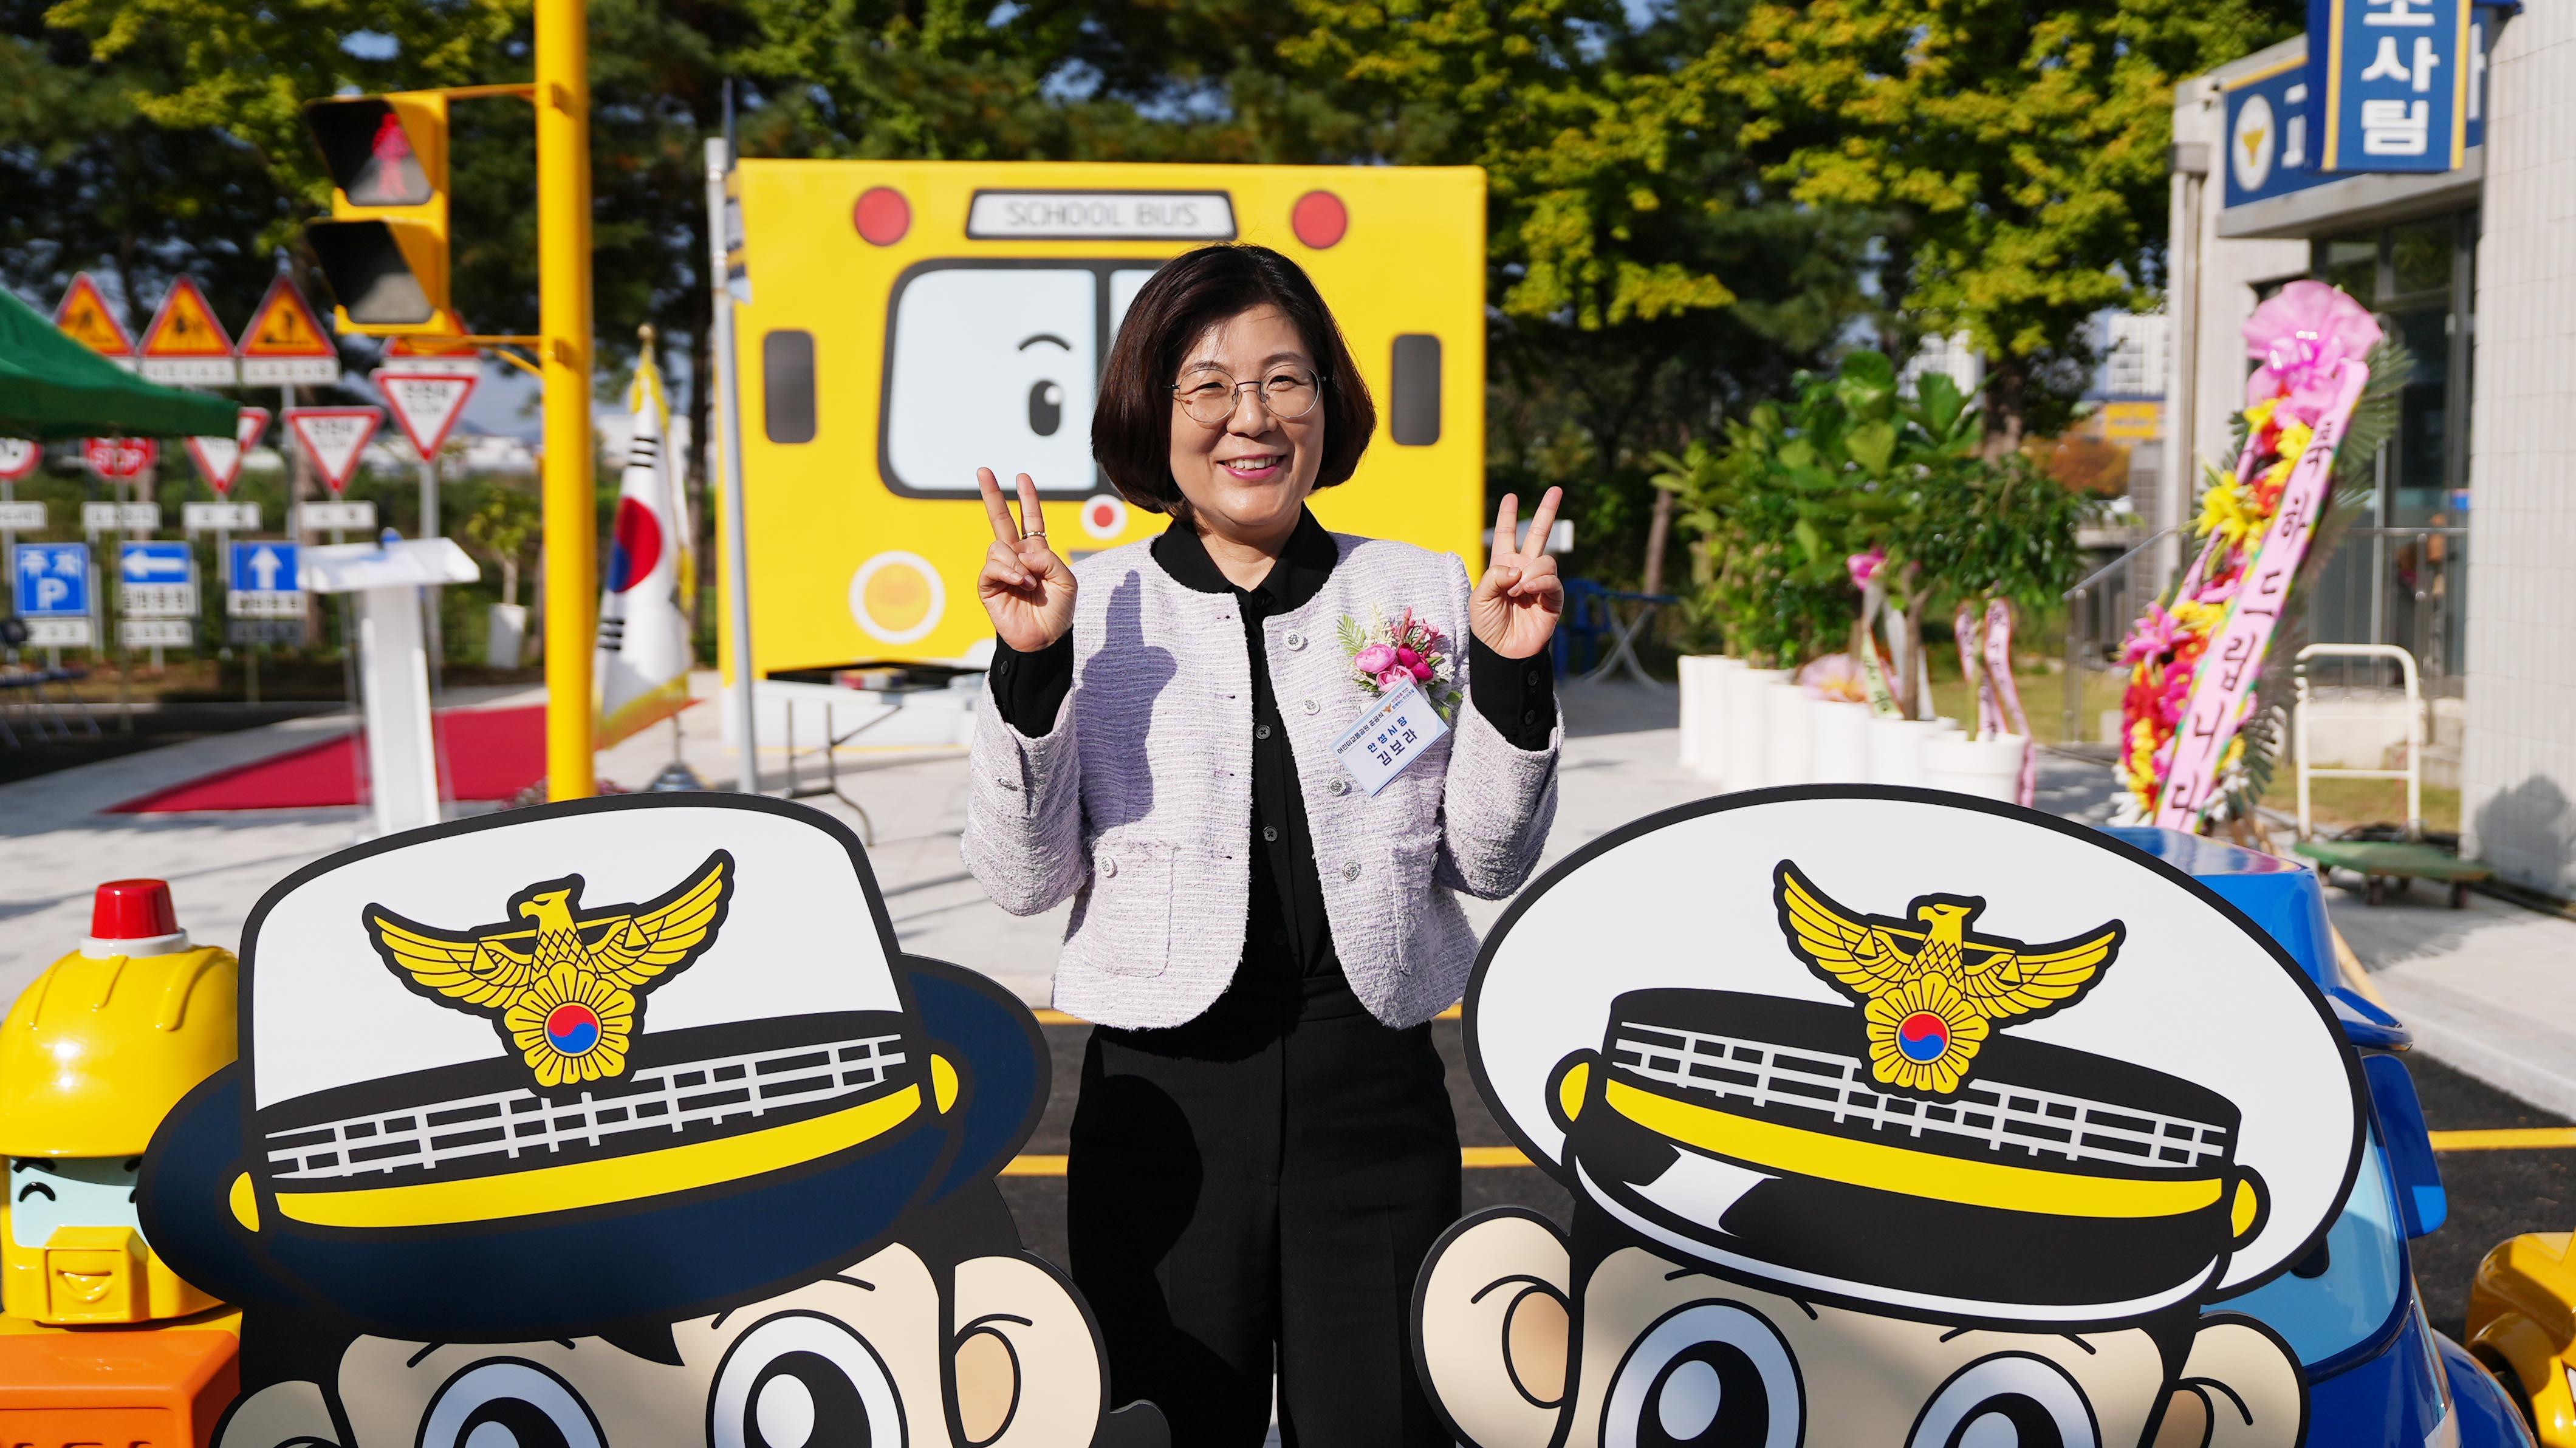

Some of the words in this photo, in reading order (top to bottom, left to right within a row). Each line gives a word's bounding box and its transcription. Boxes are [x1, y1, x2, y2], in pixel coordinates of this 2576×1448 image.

[1007, 200, 1124, 227] SCHOOL
[1136, 201, 1198, 227] BUS
[37, 577, 69, 610] P
[1337, 723, 1371, 755] 어린이교통공원
[1368, 711, 1385, 728] 준공식
